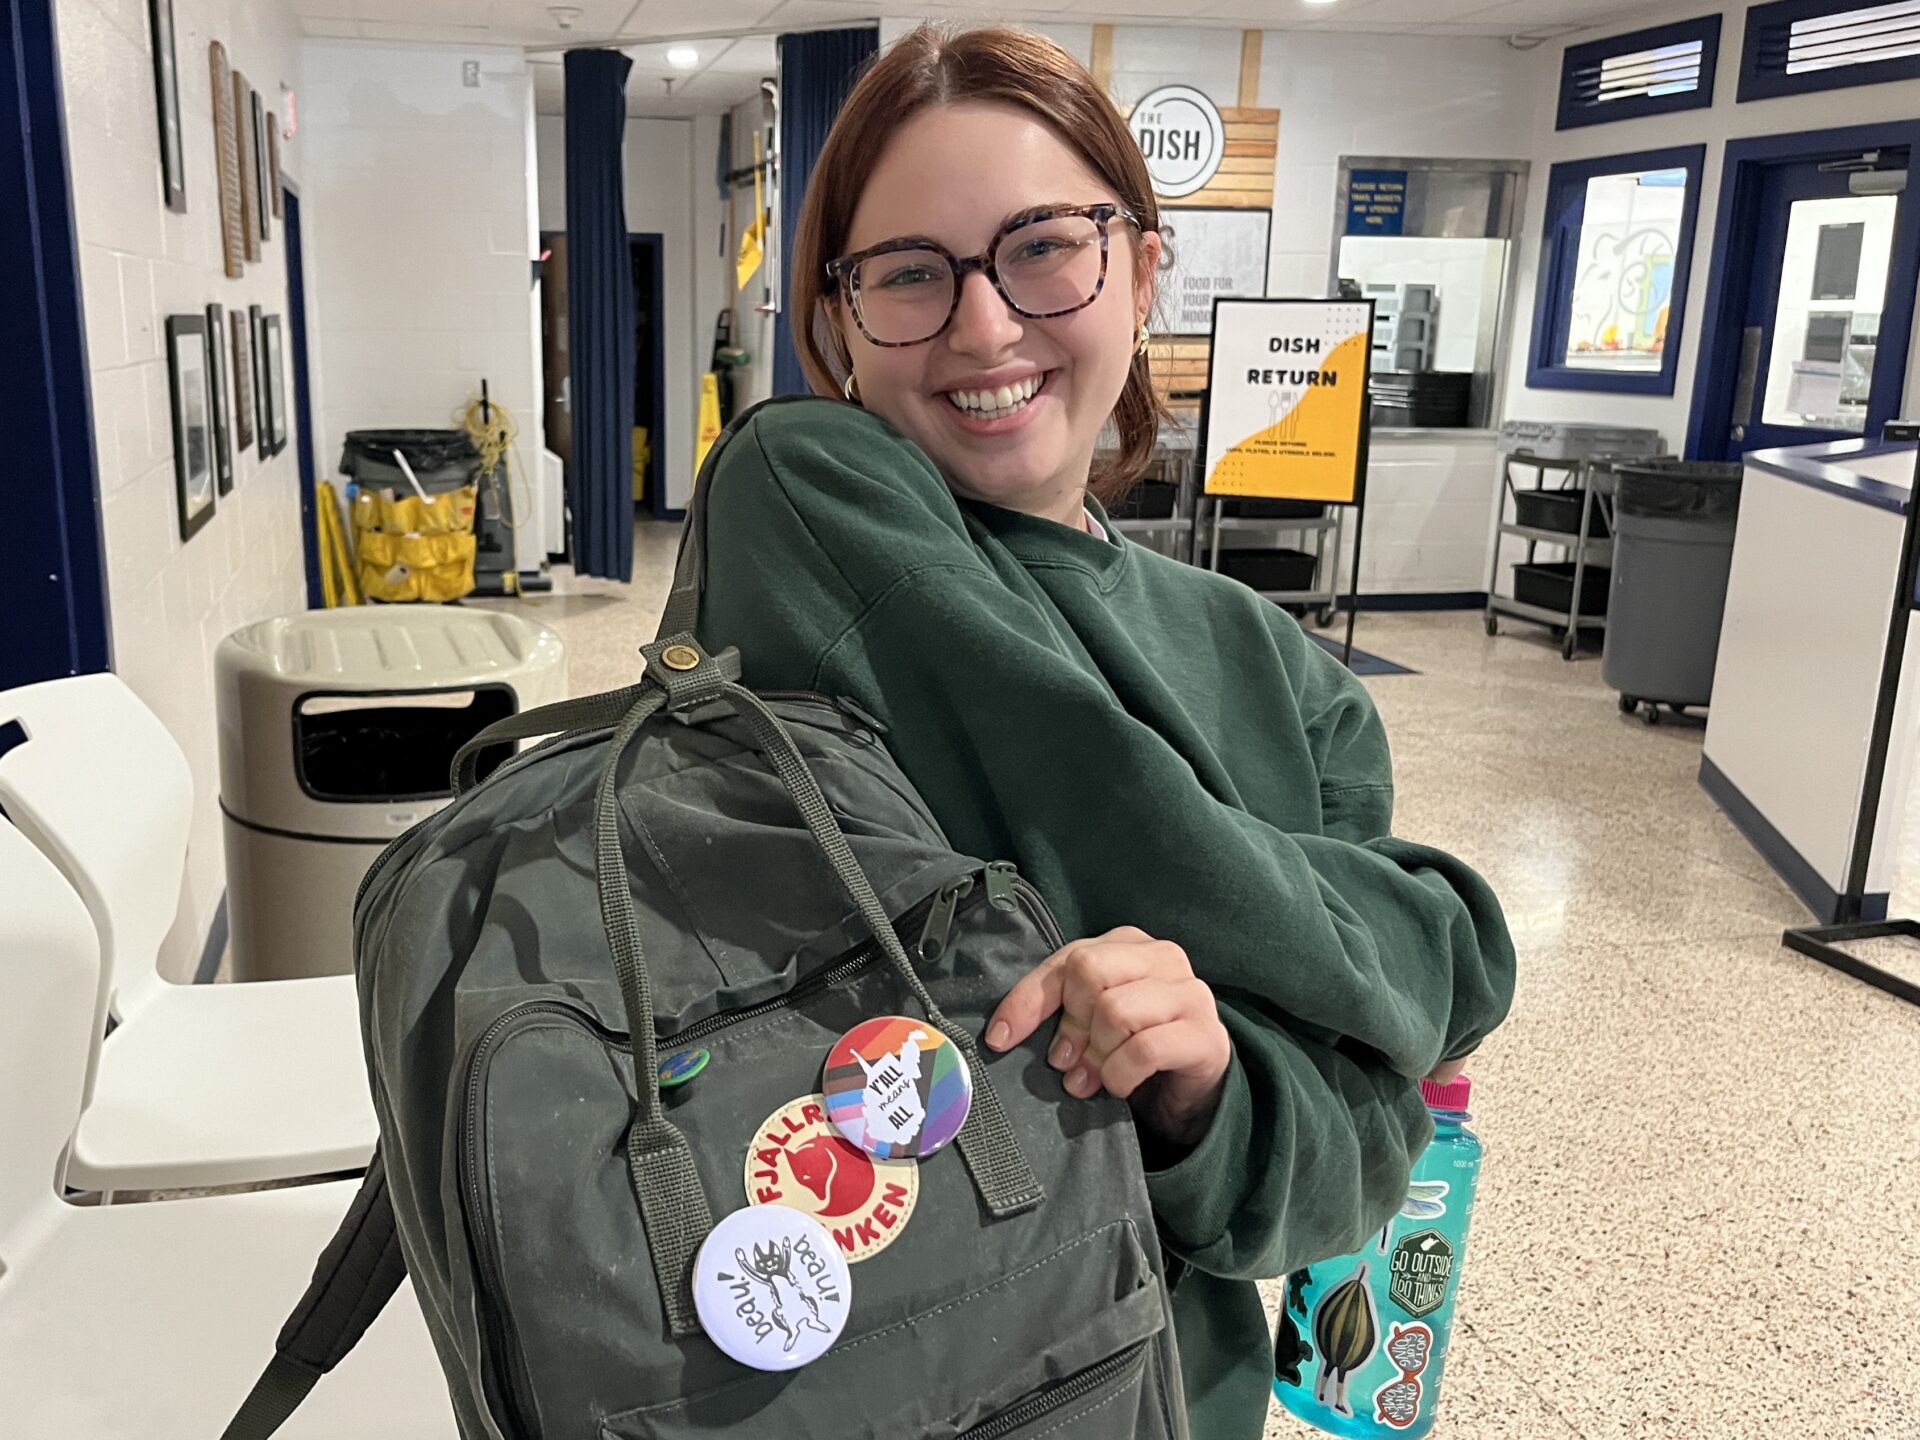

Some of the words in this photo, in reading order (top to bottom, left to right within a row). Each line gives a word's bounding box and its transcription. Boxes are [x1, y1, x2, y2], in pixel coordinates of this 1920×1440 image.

[1140, 112, 1162, 125] THE
[1140, 128, 1200, 161] DISH
[1182, 276, 1210, 290] FOOD
[1213, 276, 1233, 289] FOR
[1183, 293, 1210, 306] YOUR
[1269, 337, 1321, 354] DISH
[1247, 369, 1337, 387] RETURN
[868, 1065, 904, 1096] Y'ALL
[877, 1079, 911, 1112] means
[888, 1105, 914, 1131] ALL
[752, 1103, 833, 1205] FJÄLLR
[831, 1181, 909, 1252] NKEN
[793, 1233, 842, 1303] beau!
[1390, 1249, 1409, 1272] GO
[1411, 1252, 1454, 1277] OUTSIDE
[1416, 1272, 1432, 1283] AND
[1397, 1279, 1412, 1298] DO
[1413, 1281, 1444, 1306] THINGS
[717, 1270, 775, 1345] beau!
[1416, 1333, 1427, 1359] NOT
[1412, 1358, 1423, 1369] A
[1406, 1383, 1417, 1401] ON
